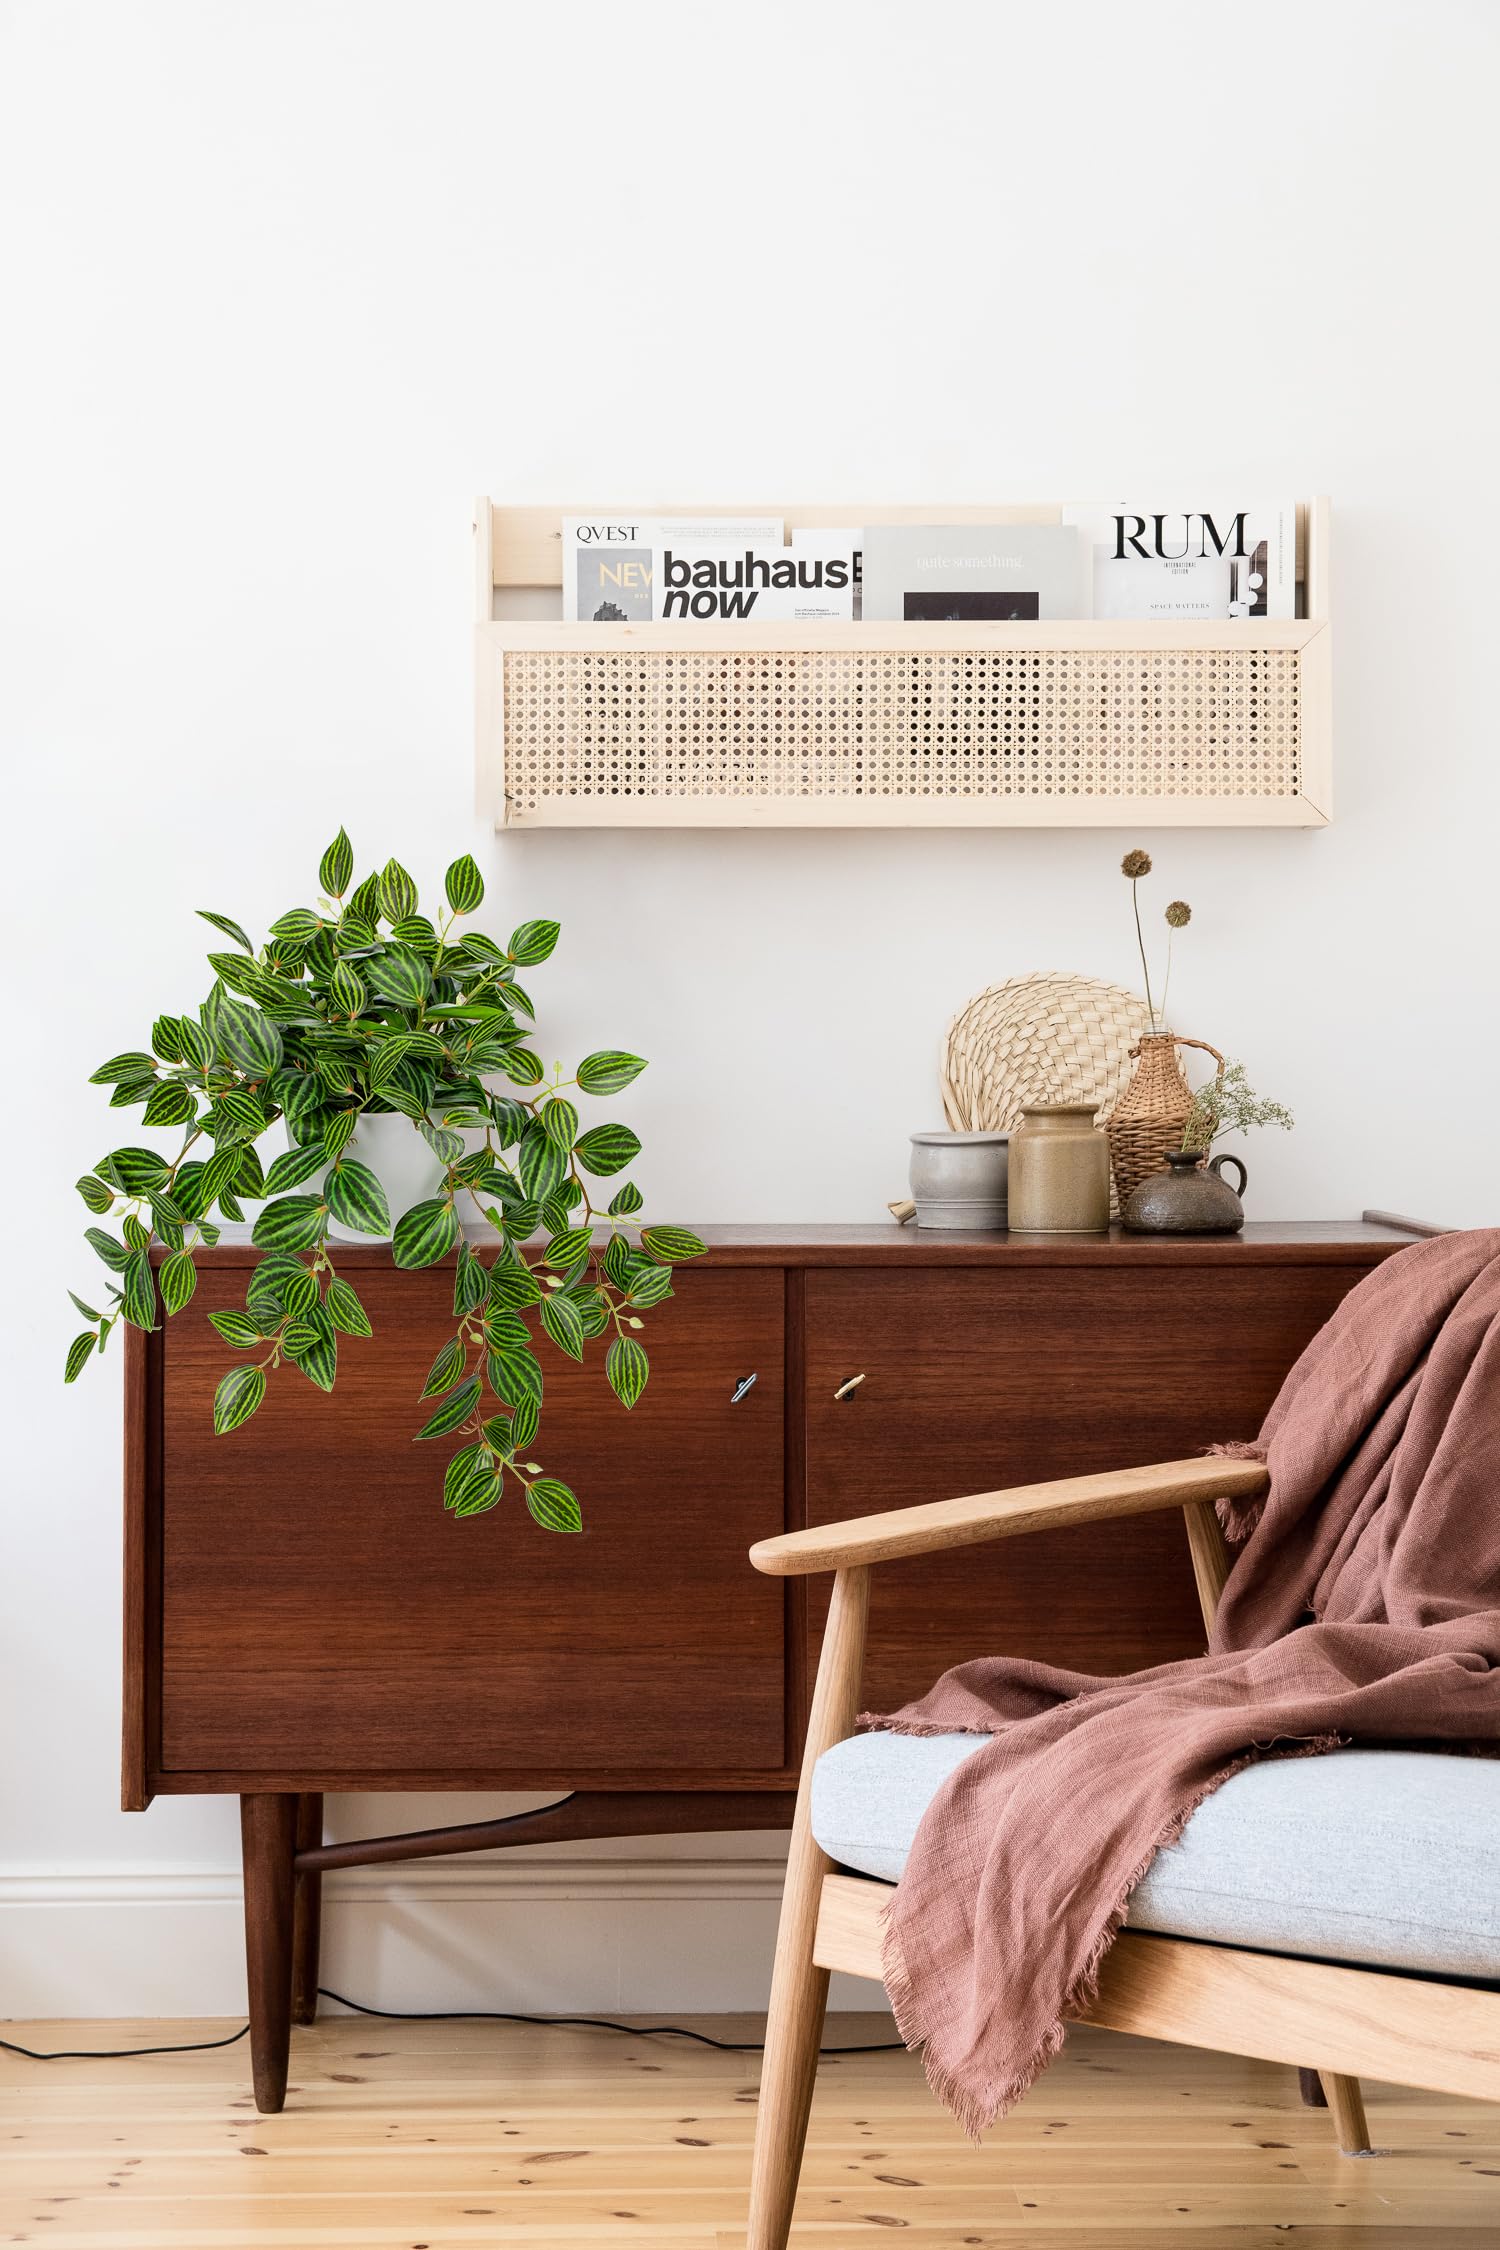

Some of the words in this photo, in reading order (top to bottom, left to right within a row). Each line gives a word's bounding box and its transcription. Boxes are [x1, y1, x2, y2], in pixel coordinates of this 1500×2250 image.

[576, 525, 639, 543] QVEST
[1110, 512, 1251, 560] RUM
[664, 551, 848, 589] bauhaus
[917, 554, 951, 571] quite
[662, 590, 759, 619] now
